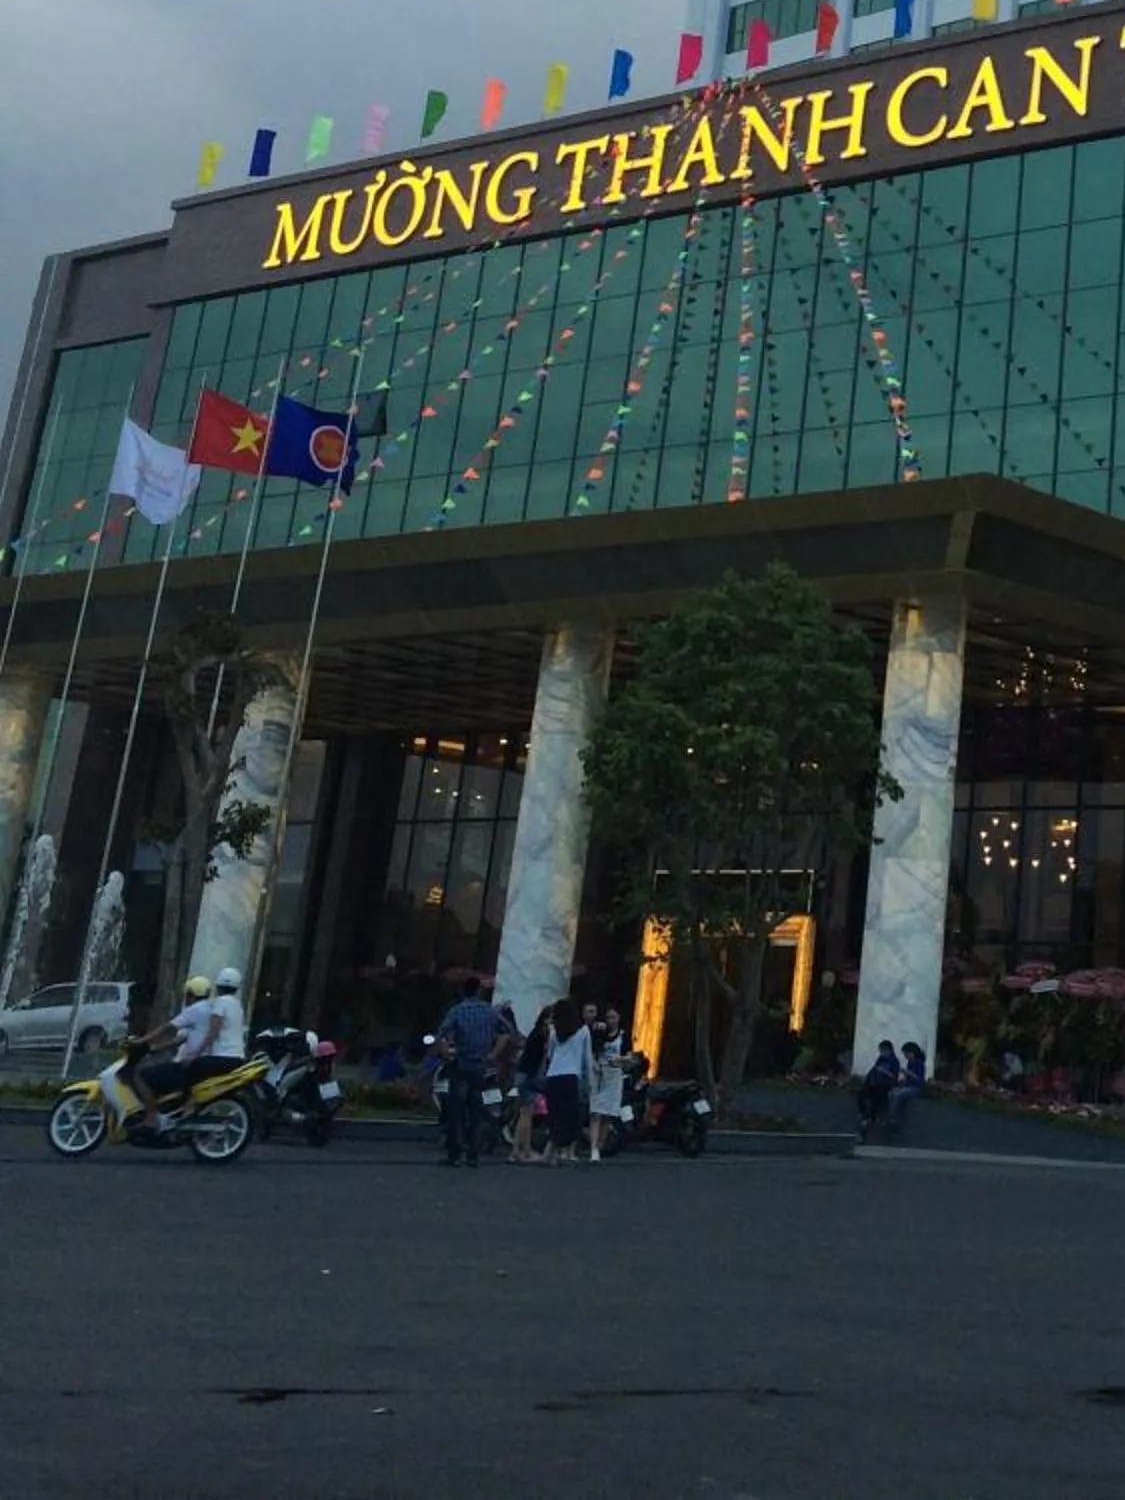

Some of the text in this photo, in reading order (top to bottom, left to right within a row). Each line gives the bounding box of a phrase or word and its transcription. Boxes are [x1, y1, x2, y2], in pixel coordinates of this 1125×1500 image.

[262, 151, 539, 269] MƯỜNG
[555, 81, 875, 213] THANH
[886, 35, 1101, 148] CAN
